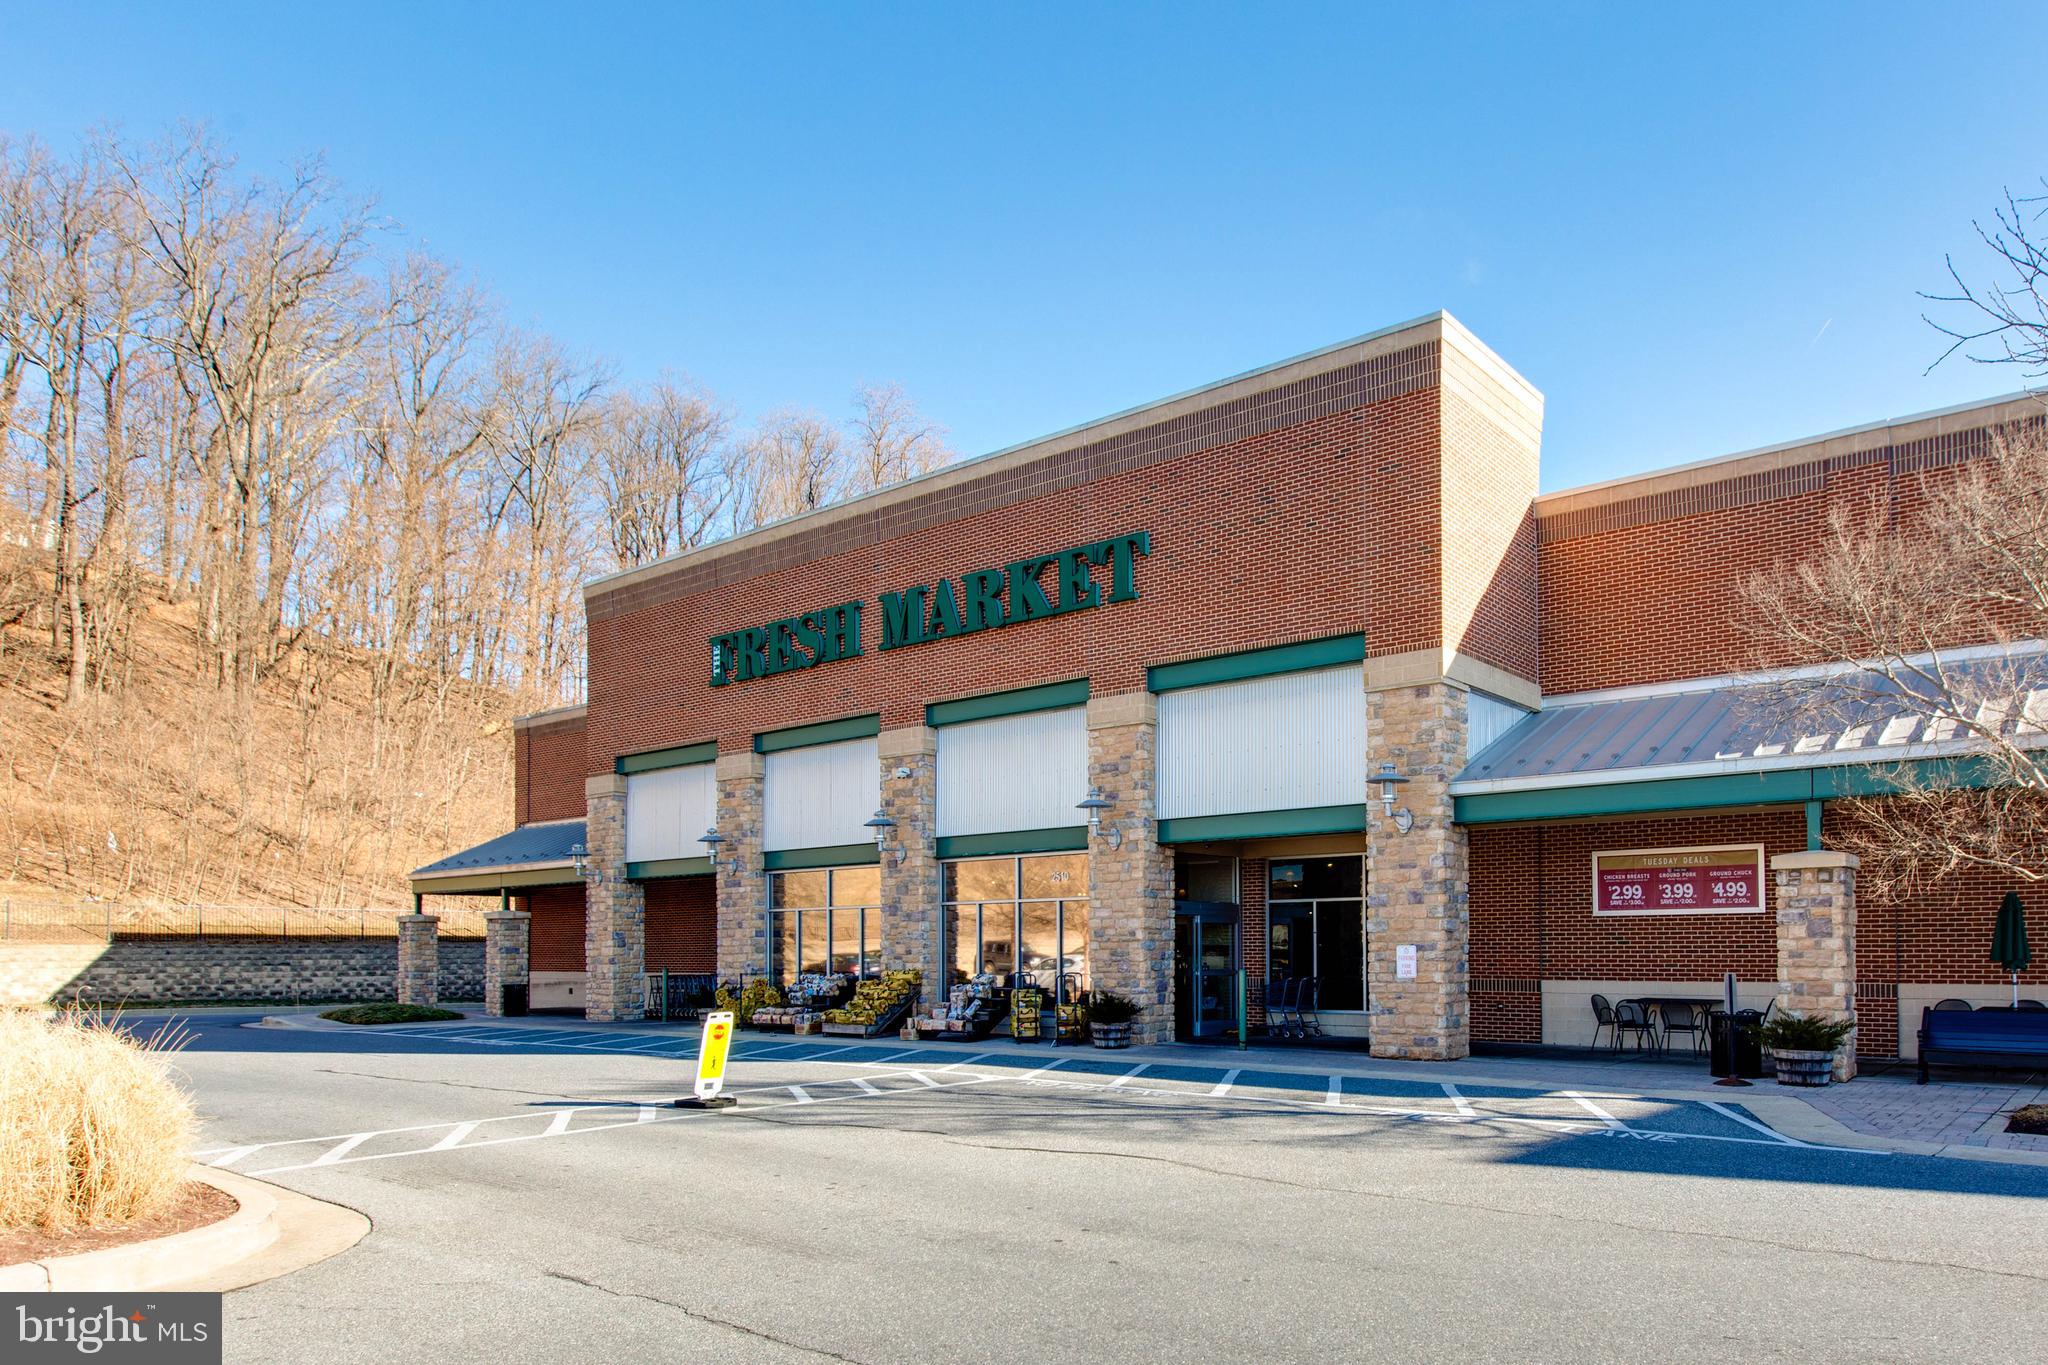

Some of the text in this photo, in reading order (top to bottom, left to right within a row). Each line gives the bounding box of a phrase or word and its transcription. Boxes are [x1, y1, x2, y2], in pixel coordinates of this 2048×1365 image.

[708, 531, 1150, 687] FRESH MARKET
[712, 645, 721, 677] THE
[1643, 855, 1709, 866] TUESDAY DEALS
[1609, 885, 1642, 900] $2.99
[1659, 883, 1694, 898] $3.99
[1712, 881, 1747, 897] $4.99
